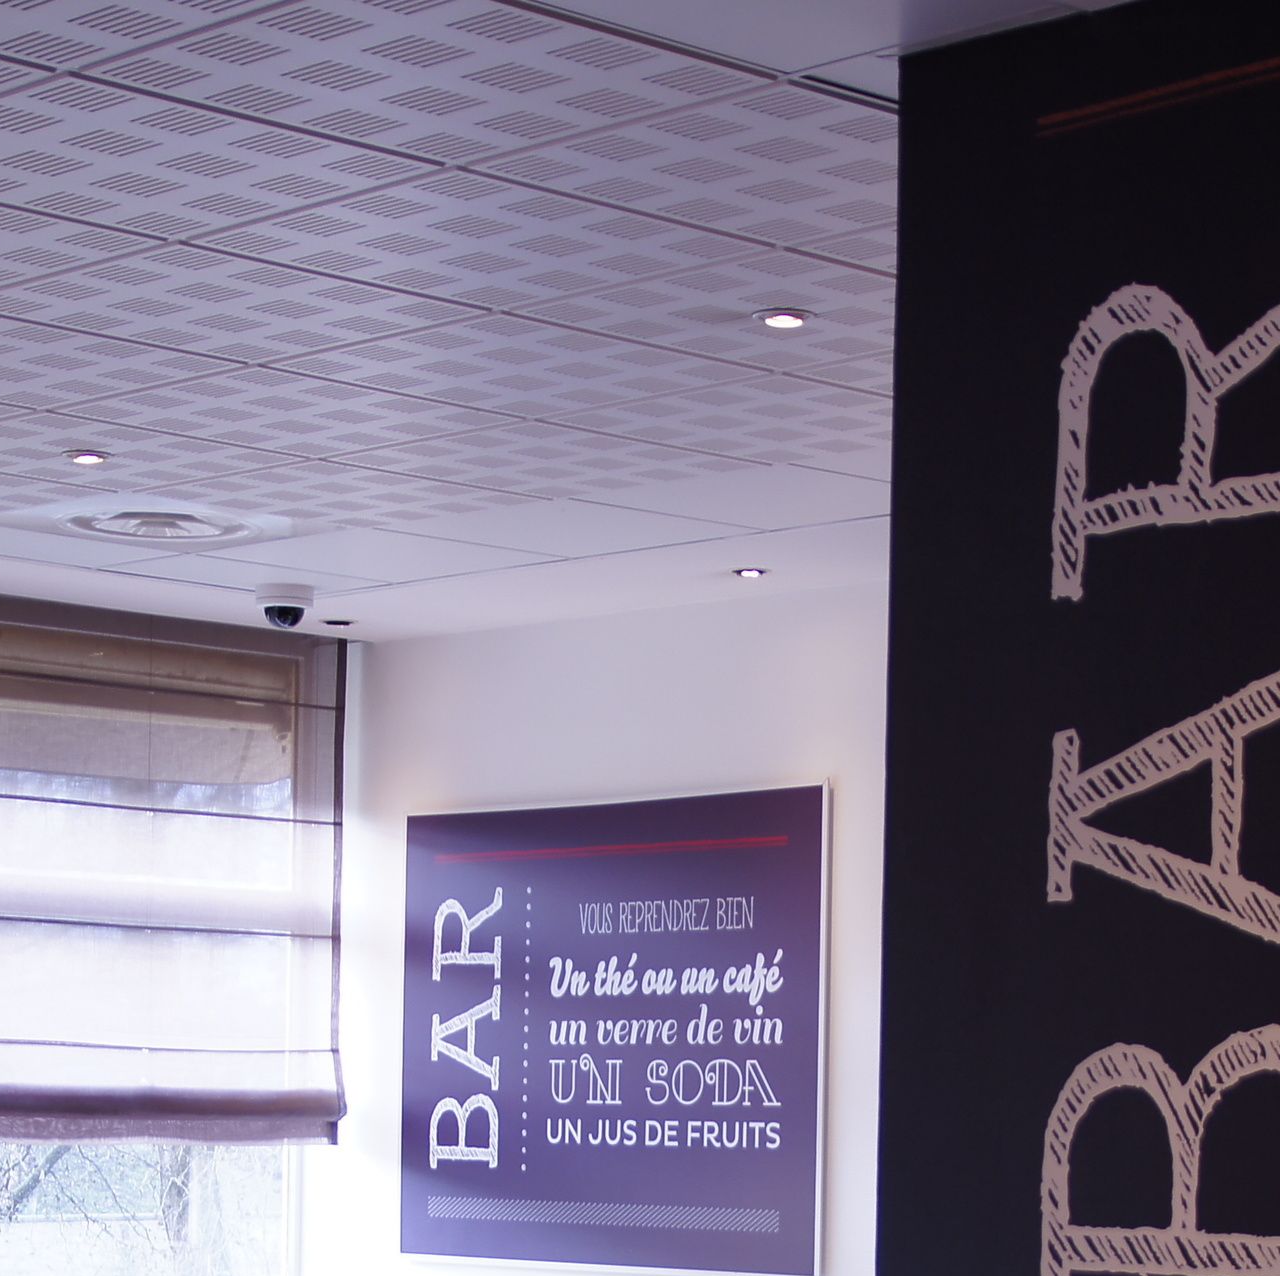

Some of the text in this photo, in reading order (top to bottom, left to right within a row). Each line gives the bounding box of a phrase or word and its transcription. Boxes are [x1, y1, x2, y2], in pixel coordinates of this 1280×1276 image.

[579, 896, 754, 934] VOUS REPRENDREZ BIEN
[549, 948, 784, 1006] Un thé ou un café
[428, 886, 503, 1169] BAR
[549, 1003, 783, 1045] un verre de vin
[549, 1053, 782, 1106] UN SODA
[546, 1118, 781, 1149] UN JUS DE FRUITS
